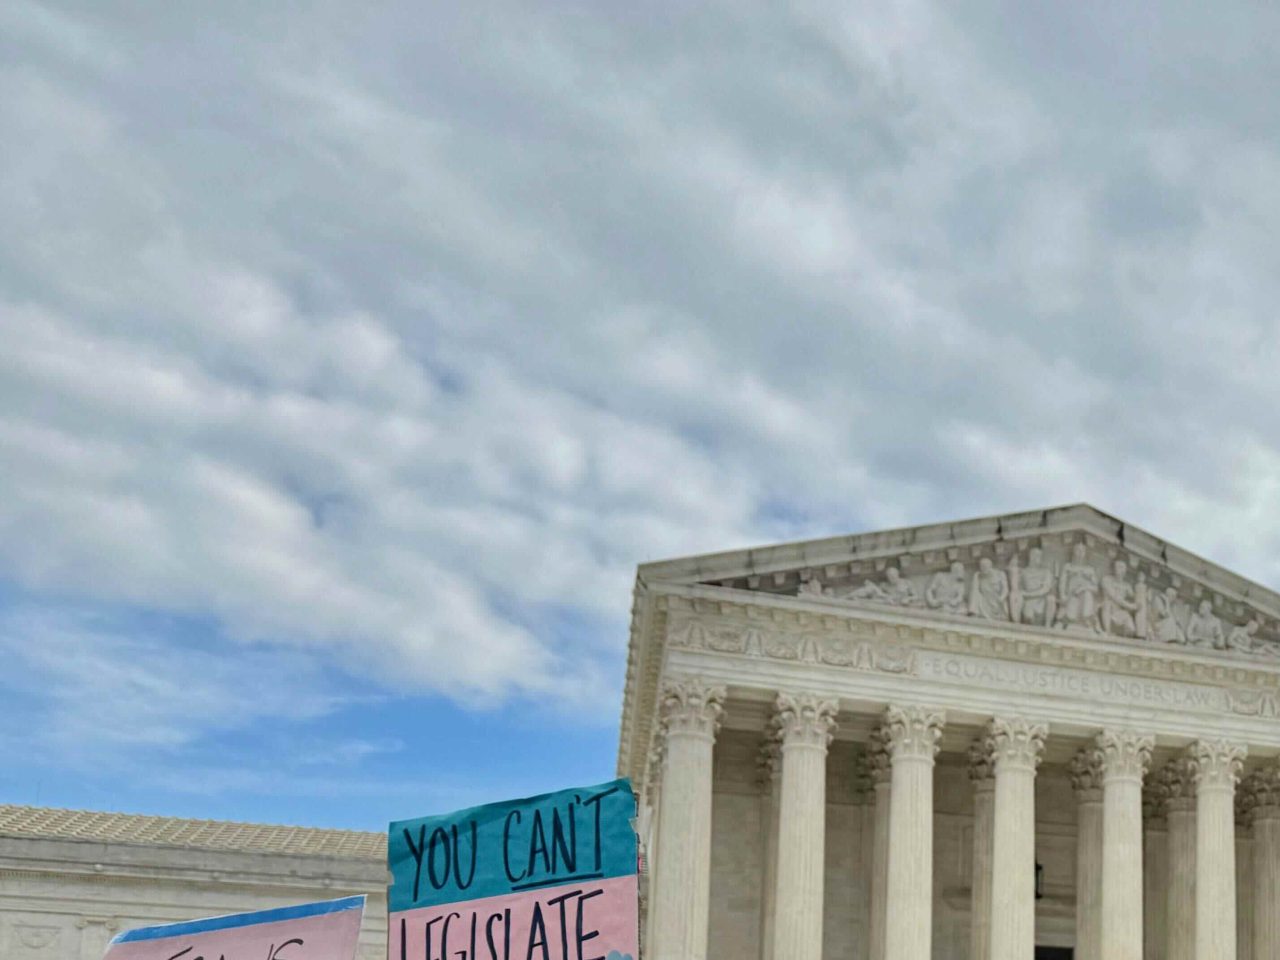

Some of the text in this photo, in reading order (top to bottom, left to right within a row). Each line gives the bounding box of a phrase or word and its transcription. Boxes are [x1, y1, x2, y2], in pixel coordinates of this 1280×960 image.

[932, 656, 1007, 682] EQUAL
[1009, 667, 1089, 693] JUSTICE
[1101, 680, 1164, 702] UNDER
[403, 787, 619, 902] YOU CAN'T
